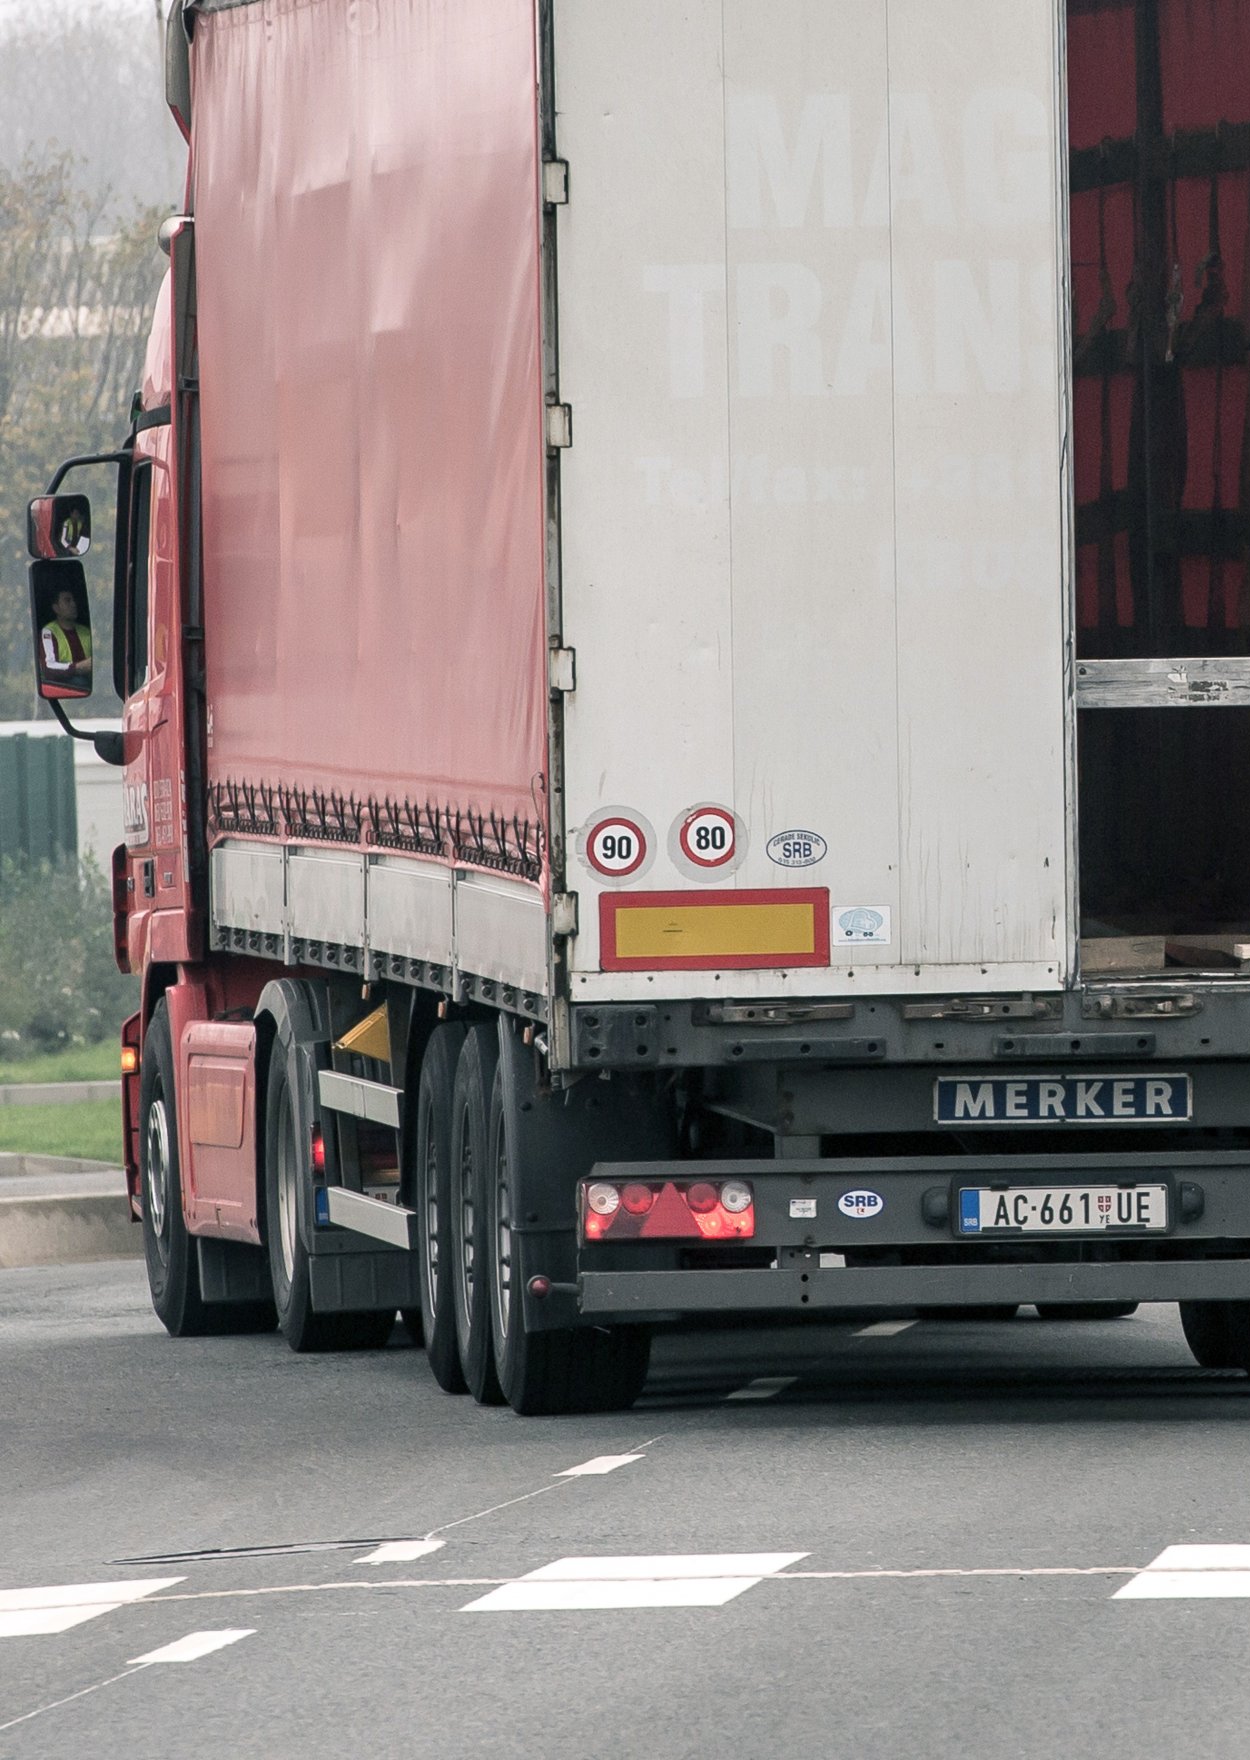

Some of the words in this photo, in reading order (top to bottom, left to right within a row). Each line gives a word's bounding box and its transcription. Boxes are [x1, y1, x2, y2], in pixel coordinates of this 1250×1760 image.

[602, 835, 632, 859] 90
[696, 826, 726, 850] 80
[782, 841, 813, 858] SRB
[954, 1081, 1173, 1117] MERKER
[844, 1195, 878, 1207] SRB
[1117, 1192, 1151, 1223] UE
[964, 1218, 978, 1227] SRB
